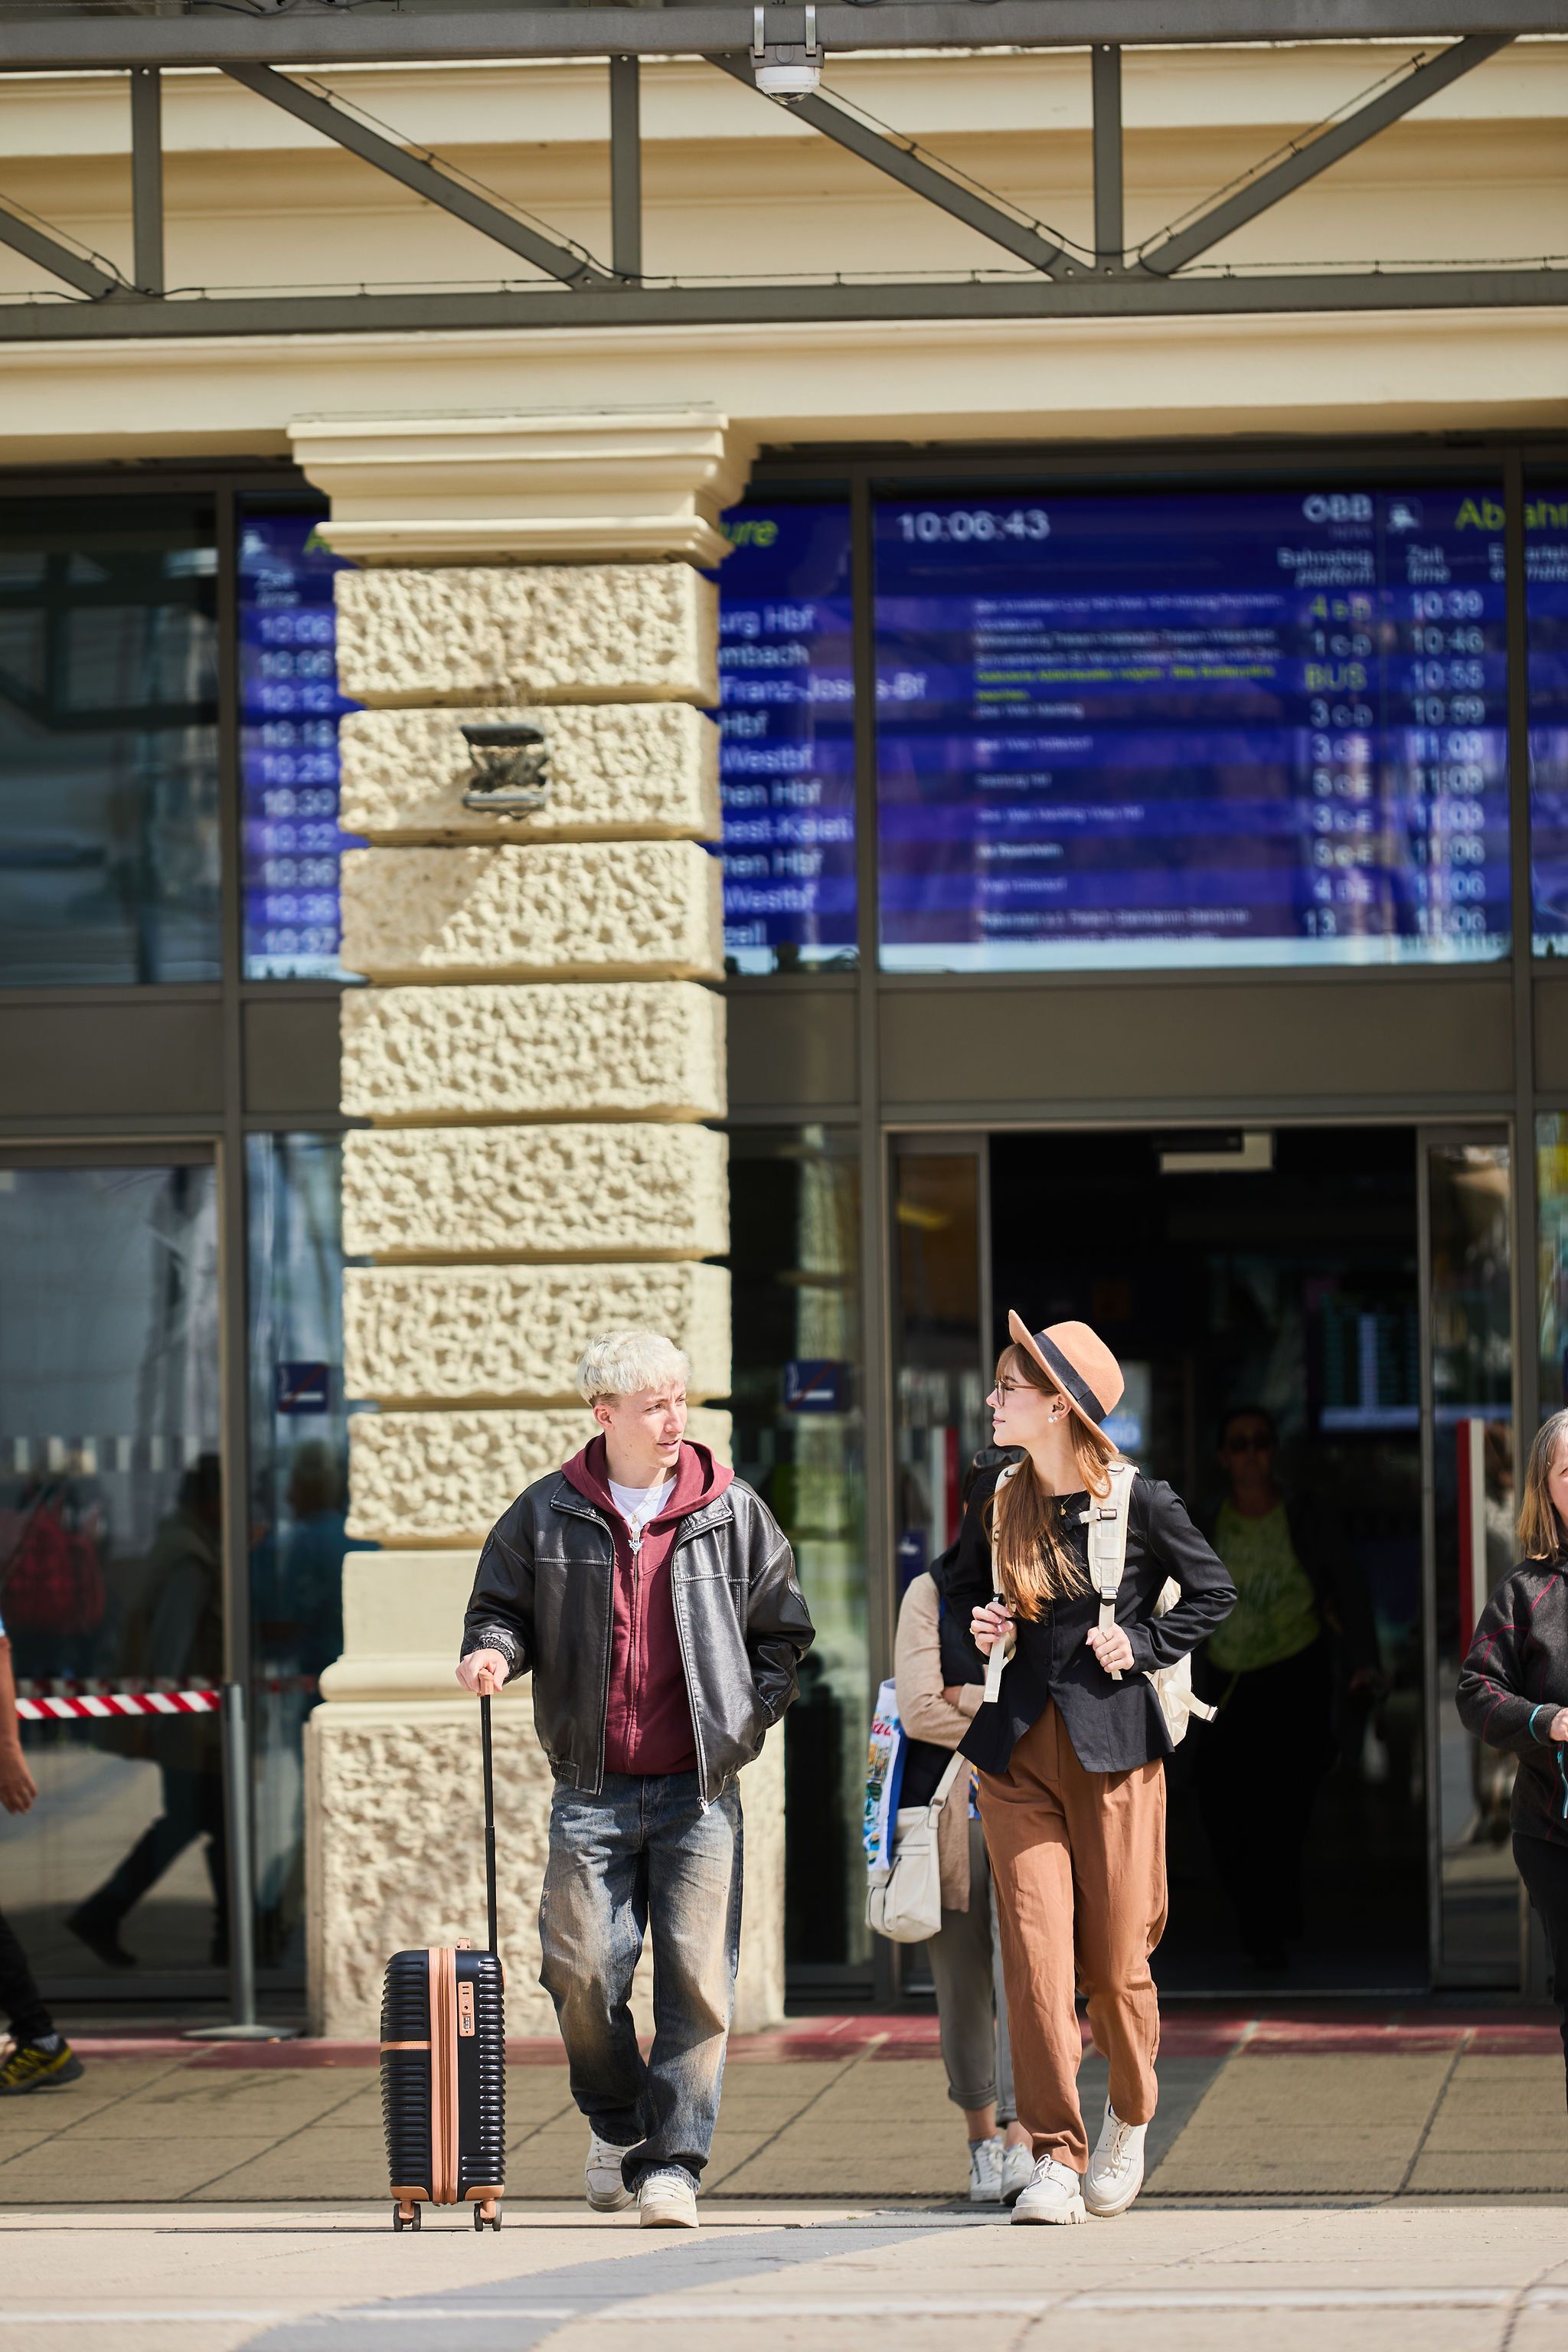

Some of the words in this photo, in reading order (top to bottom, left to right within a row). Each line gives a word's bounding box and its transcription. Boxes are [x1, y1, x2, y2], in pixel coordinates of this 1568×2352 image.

[896, 508, 1050, 543] 10:06:43
[764, 604, 816, 632] Hbf
[1310, 594, 1328, 619] 4
[1411, 590, 1484, 619] 10:39
[717, 641, 810, 668] mbach
[1312, 629, 1326, 656] 1
[1304, 662, 1367, 691] BUS
[260, 684, 334, 713] 10:12
[1310, 698, 1330, 728] 3
[717, 710, 770, 739] Hbf
[1312, 733, 1331, 763] 3
[771, 778, 824, 807] Hbf
[261, 823, 337, 853] 10:32
[772, 847, 825, 877] Hbf
[1313, 874, 1332, 902] 4
